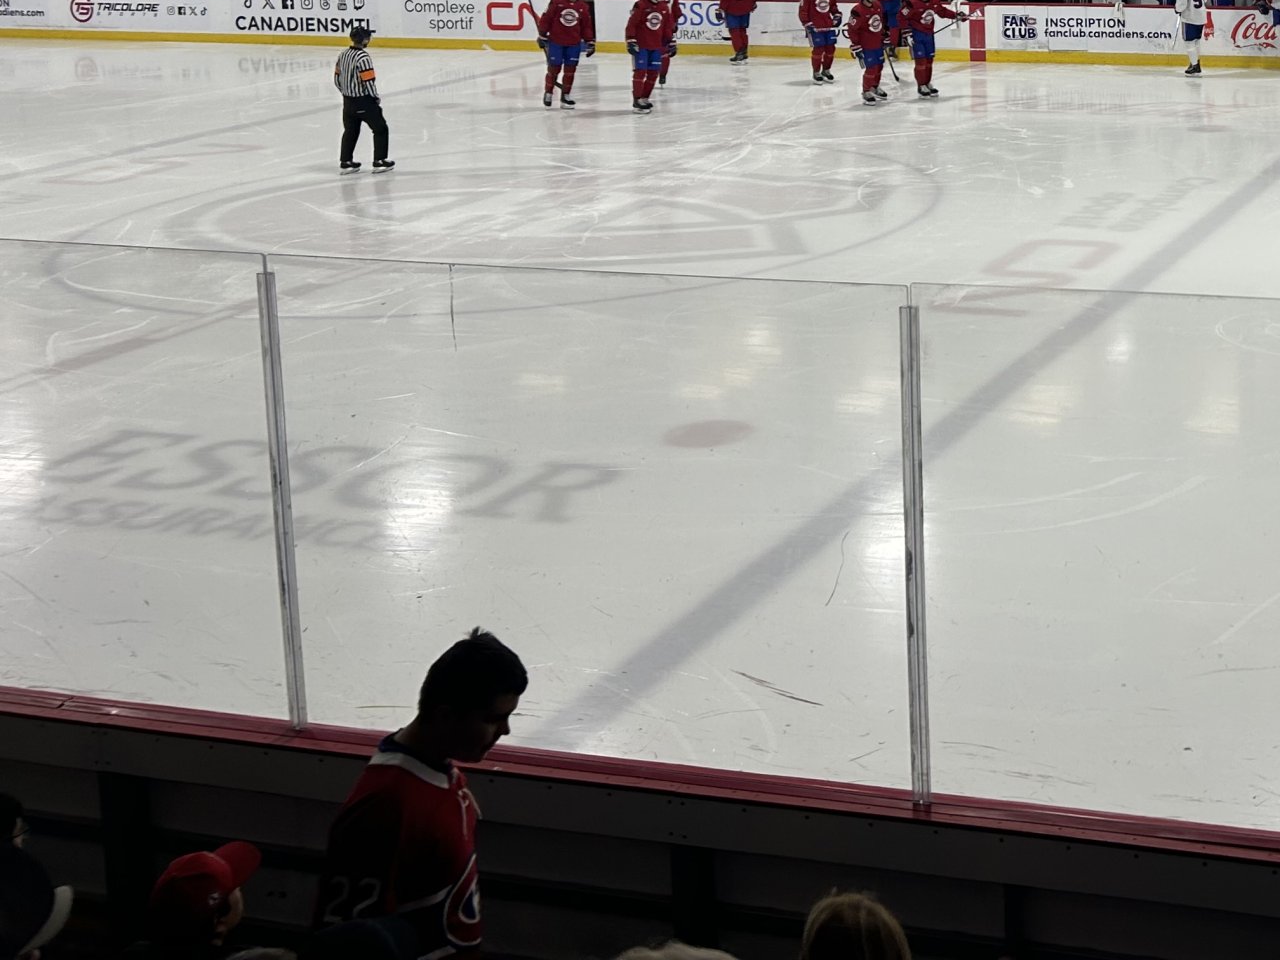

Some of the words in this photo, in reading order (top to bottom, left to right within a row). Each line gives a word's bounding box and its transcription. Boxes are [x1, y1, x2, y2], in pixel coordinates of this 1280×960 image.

[97, 2, 160, 12] TRICOLORE
[404, 0, 475, 16] Complexe
[429, 17, 474, 32] sportif
[1003, 16, 1027, 27] FAN
[1045, 18, 1126, 28] INSCRIPTION
[1003, 28, 1036, 39] CLUB
